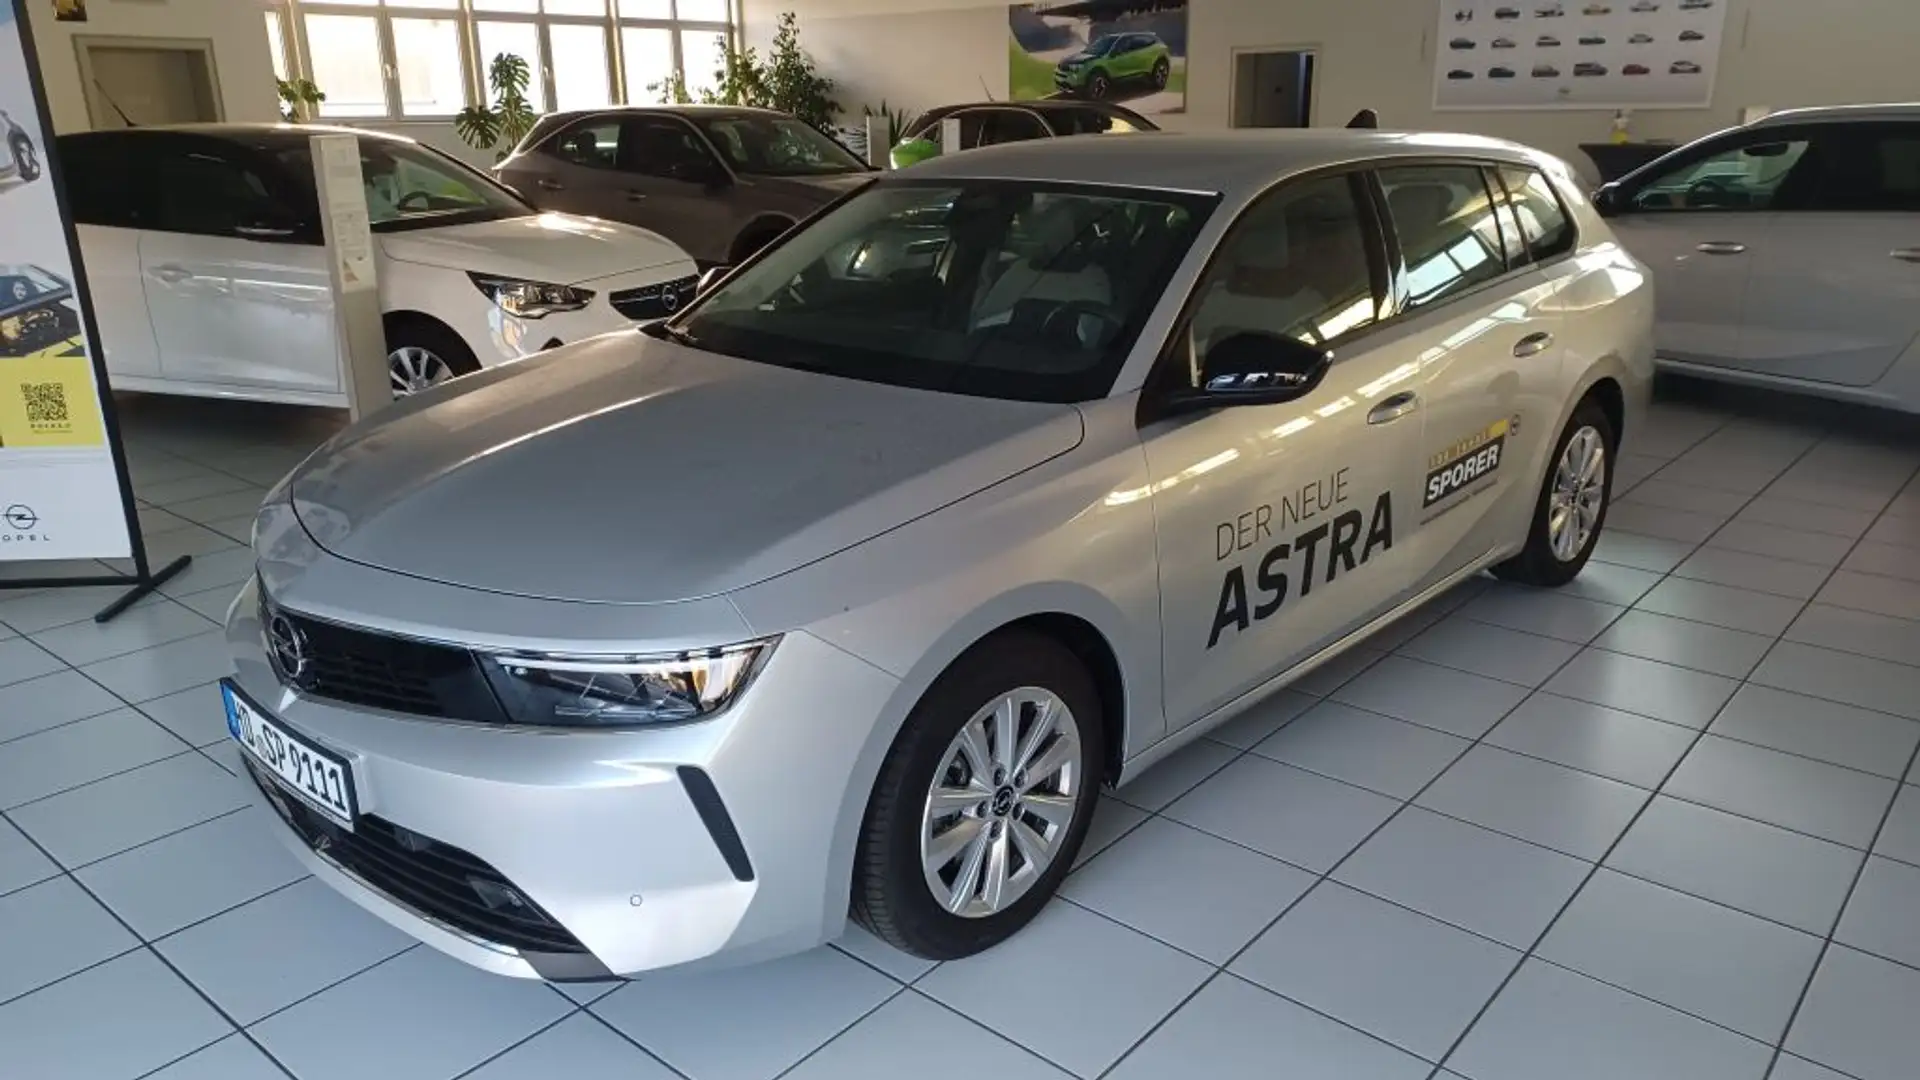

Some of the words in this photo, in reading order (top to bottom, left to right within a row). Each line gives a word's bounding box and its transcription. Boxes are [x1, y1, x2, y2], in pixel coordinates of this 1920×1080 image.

[1216, 504, 1273, 561] DER
[1281, 466, 1350, 531] NEUE
[1427, 443, 1500, 501] SPORER
[2, 534, 50, 542] OPEL
[1206, 490, 1393, 651] ASTRA
[261, 723, 287, 772] SP
[288, 742, 348, 813] 9111
